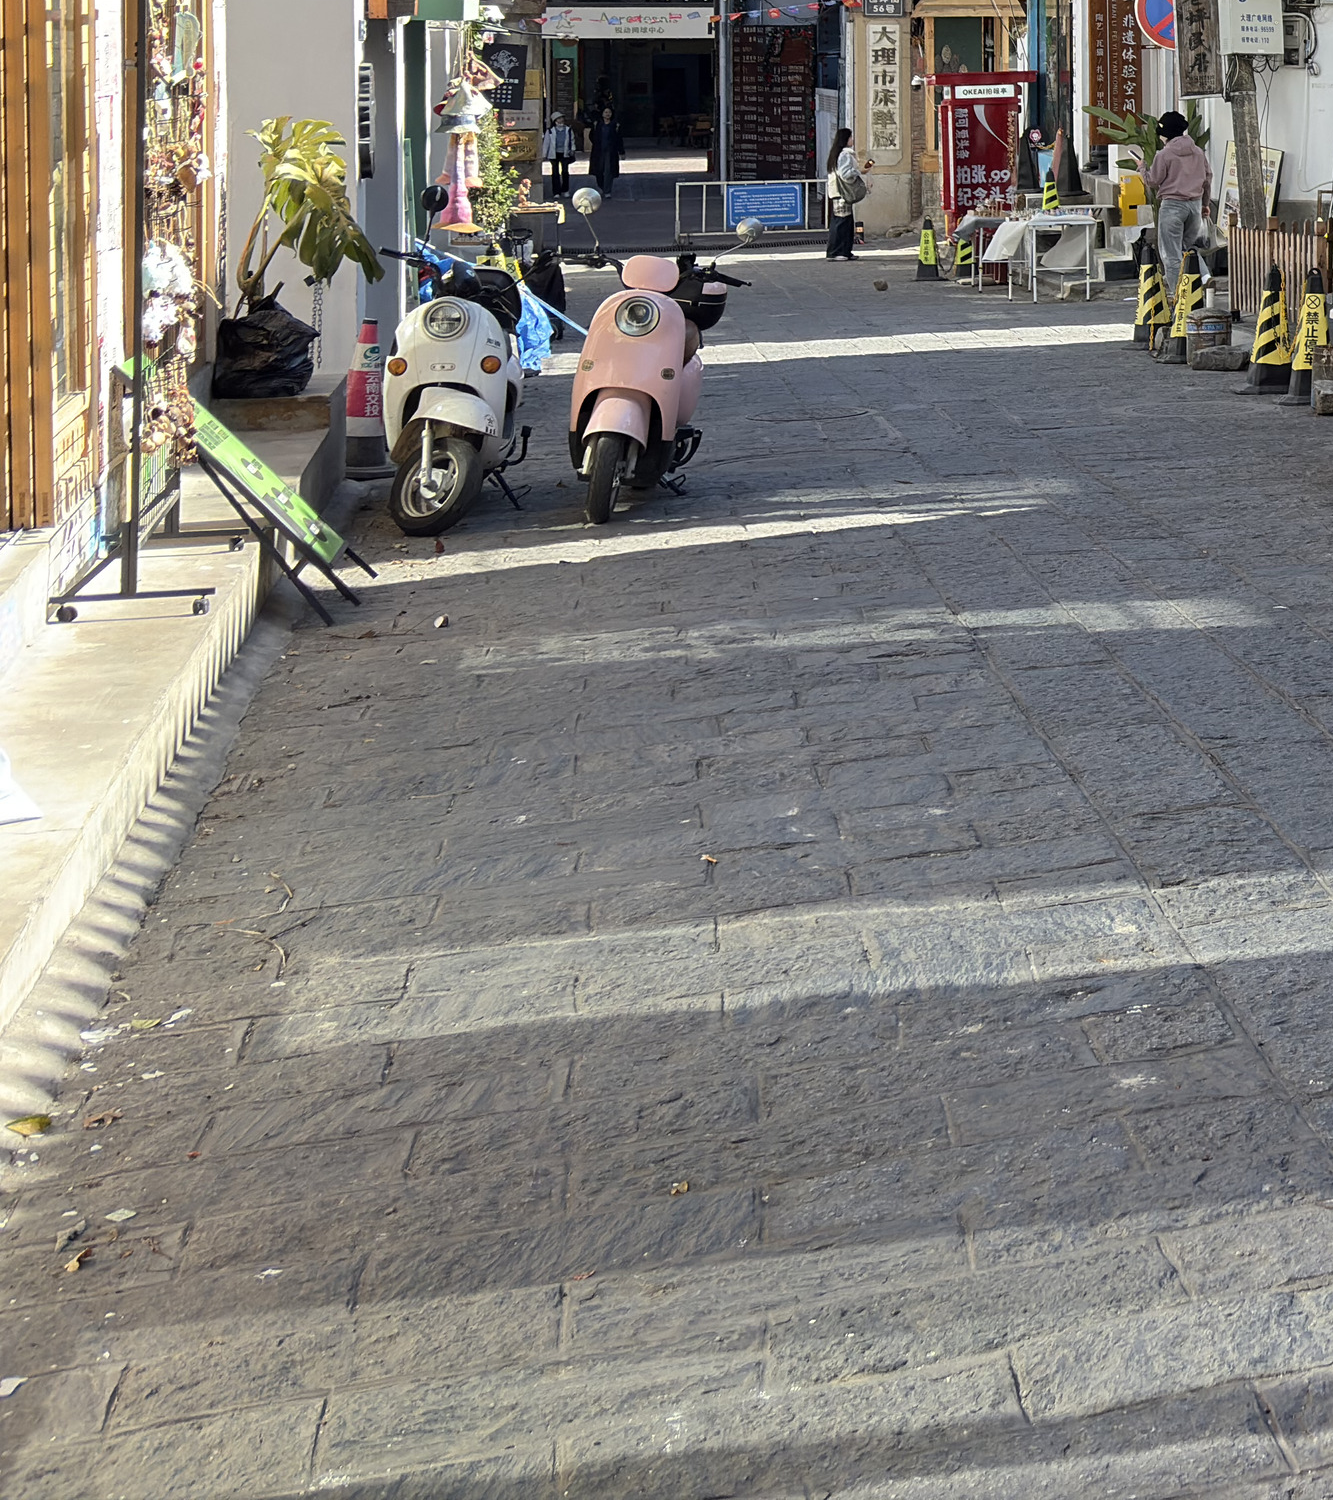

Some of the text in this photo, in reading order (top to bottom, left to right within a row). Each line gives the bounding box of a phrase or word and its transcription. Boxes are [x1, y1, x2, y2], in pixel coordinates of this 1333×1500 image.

[873, 4, 896, 14] 56号
[559, 59, 571, 74] 3
[1303, 311, 1320, 367] 禁止停车
[364, 371, 381, 417] 云南交投
